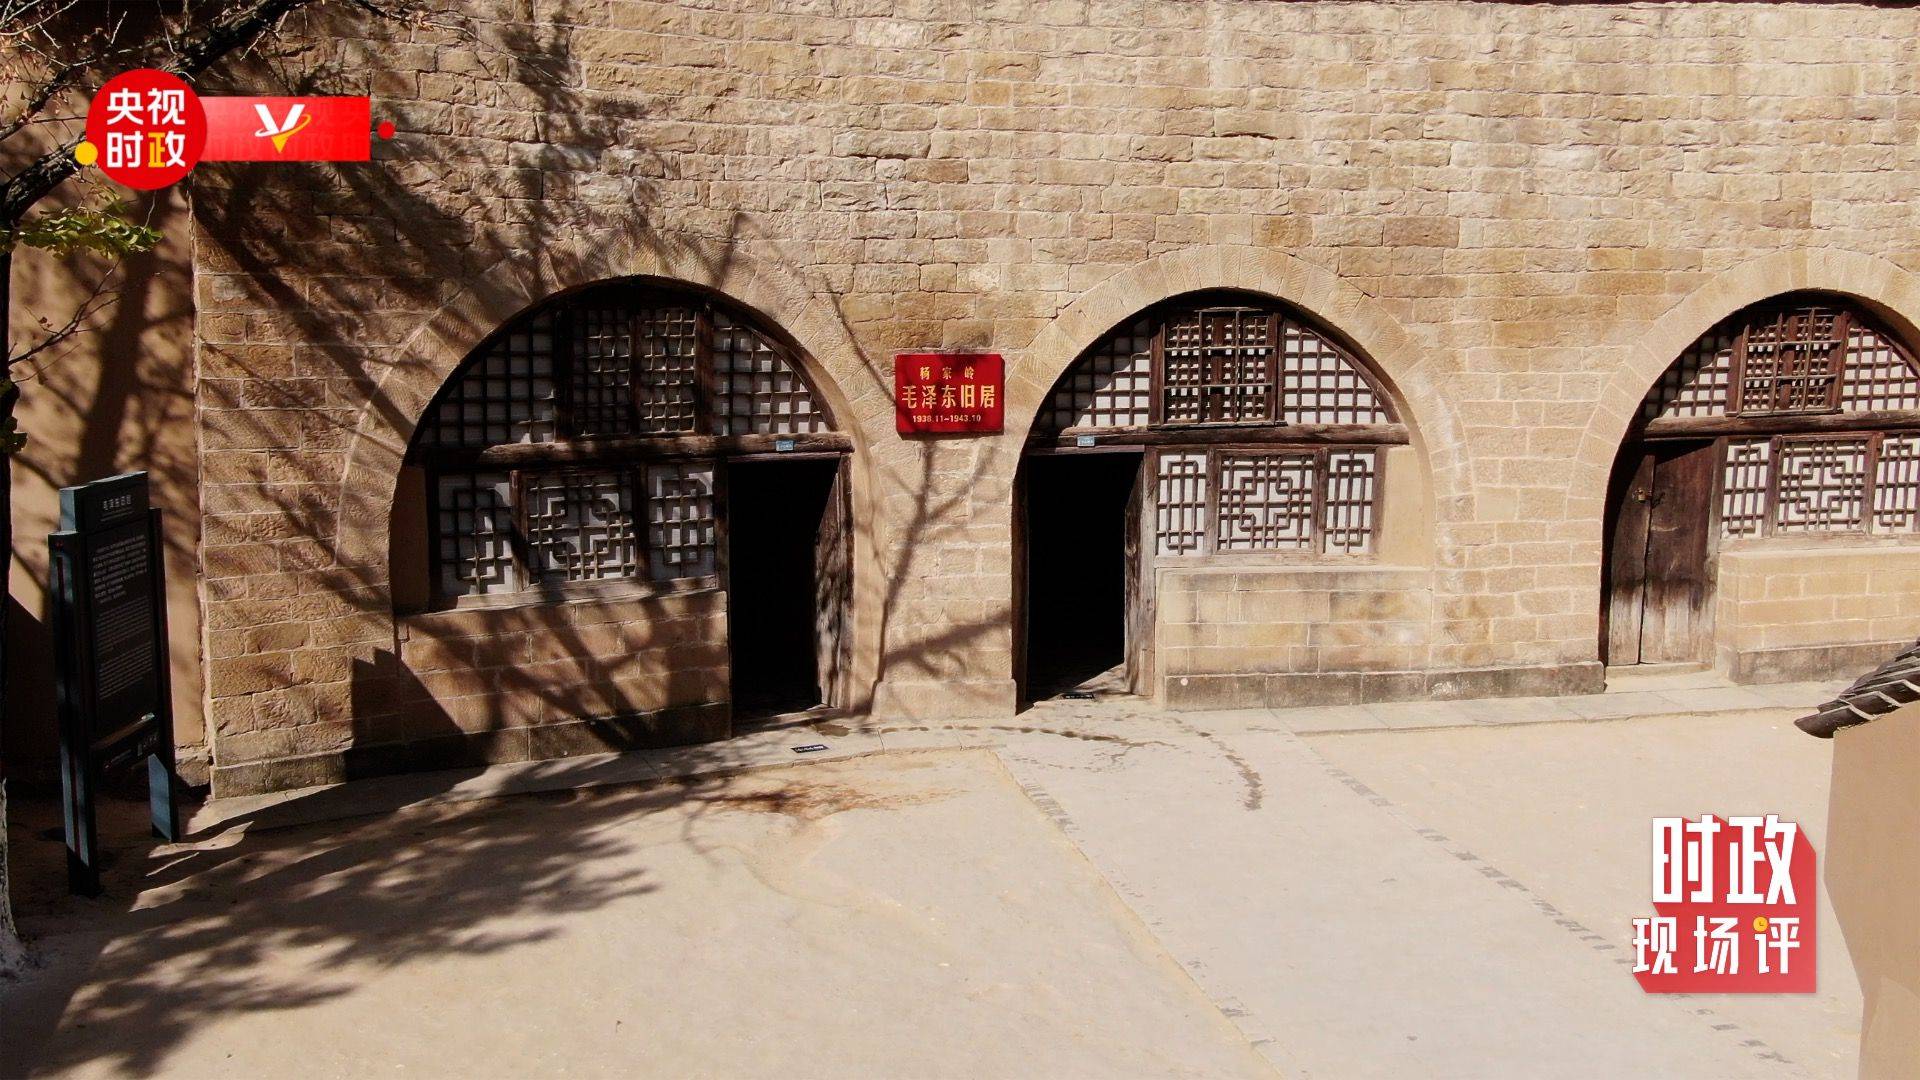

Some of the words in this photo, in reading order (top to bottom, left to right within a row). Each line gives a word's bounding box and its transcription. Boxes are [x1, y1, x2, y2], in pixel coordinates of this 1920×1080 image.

[920, 366, 975, 380] 杨家岭
[902, 384, 995, 409] 毛泽东旧居
